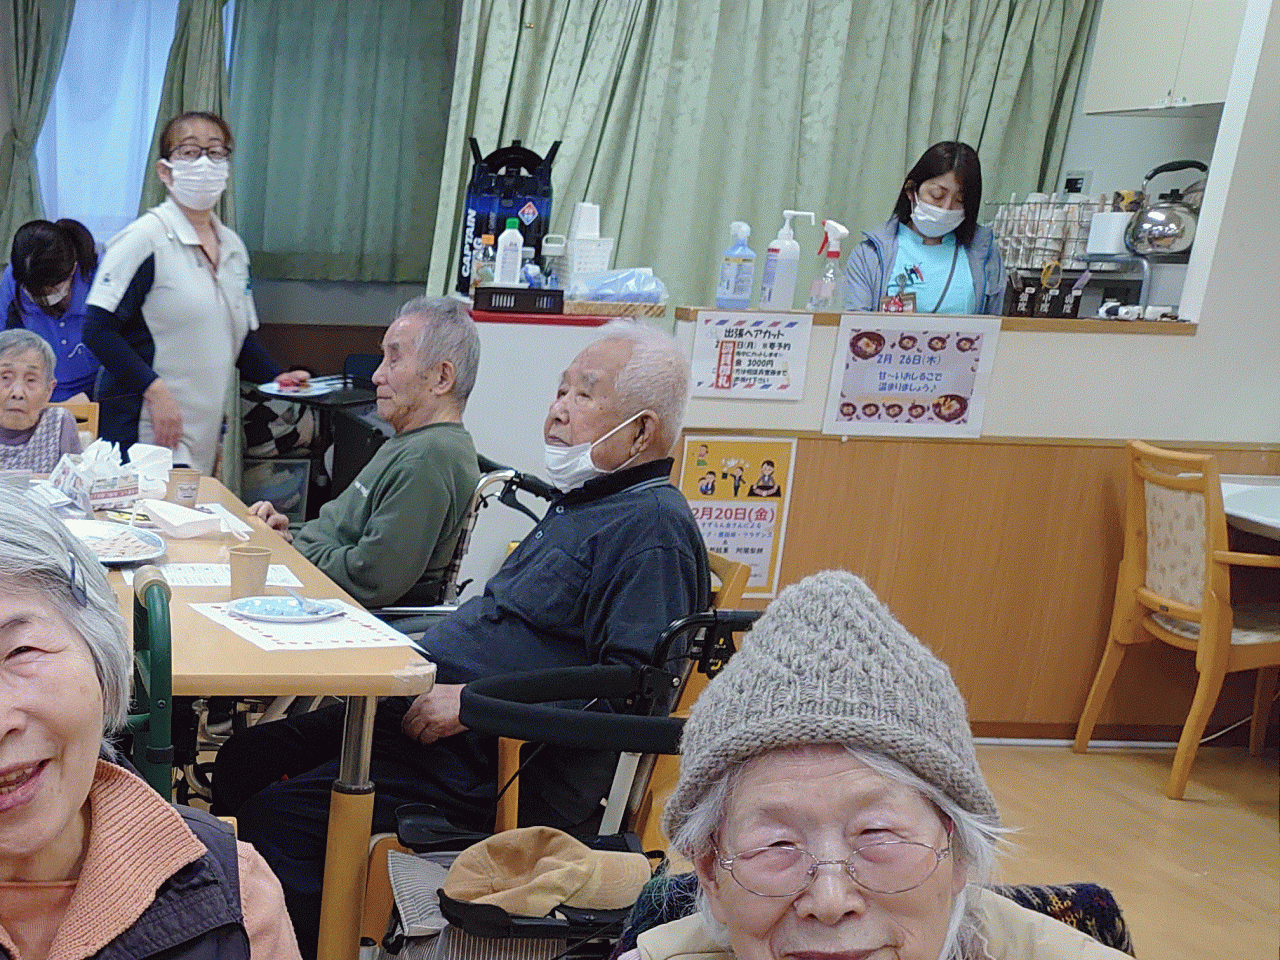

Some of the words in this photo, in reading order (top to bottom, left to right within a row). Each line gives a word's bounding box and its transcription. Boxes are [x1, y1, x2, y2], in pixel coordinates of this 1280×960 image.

[461, 208, 477, 278] CAPTAIN
[724, 328, 785, 340] 出張ヘアカット
[746, 358, 774, 368] 3000円
[876, 353, 893, 365] 2月
[898, 354, 942, 366] 26日(木)
[692, 507, 774, 523] 2月20日(金)
